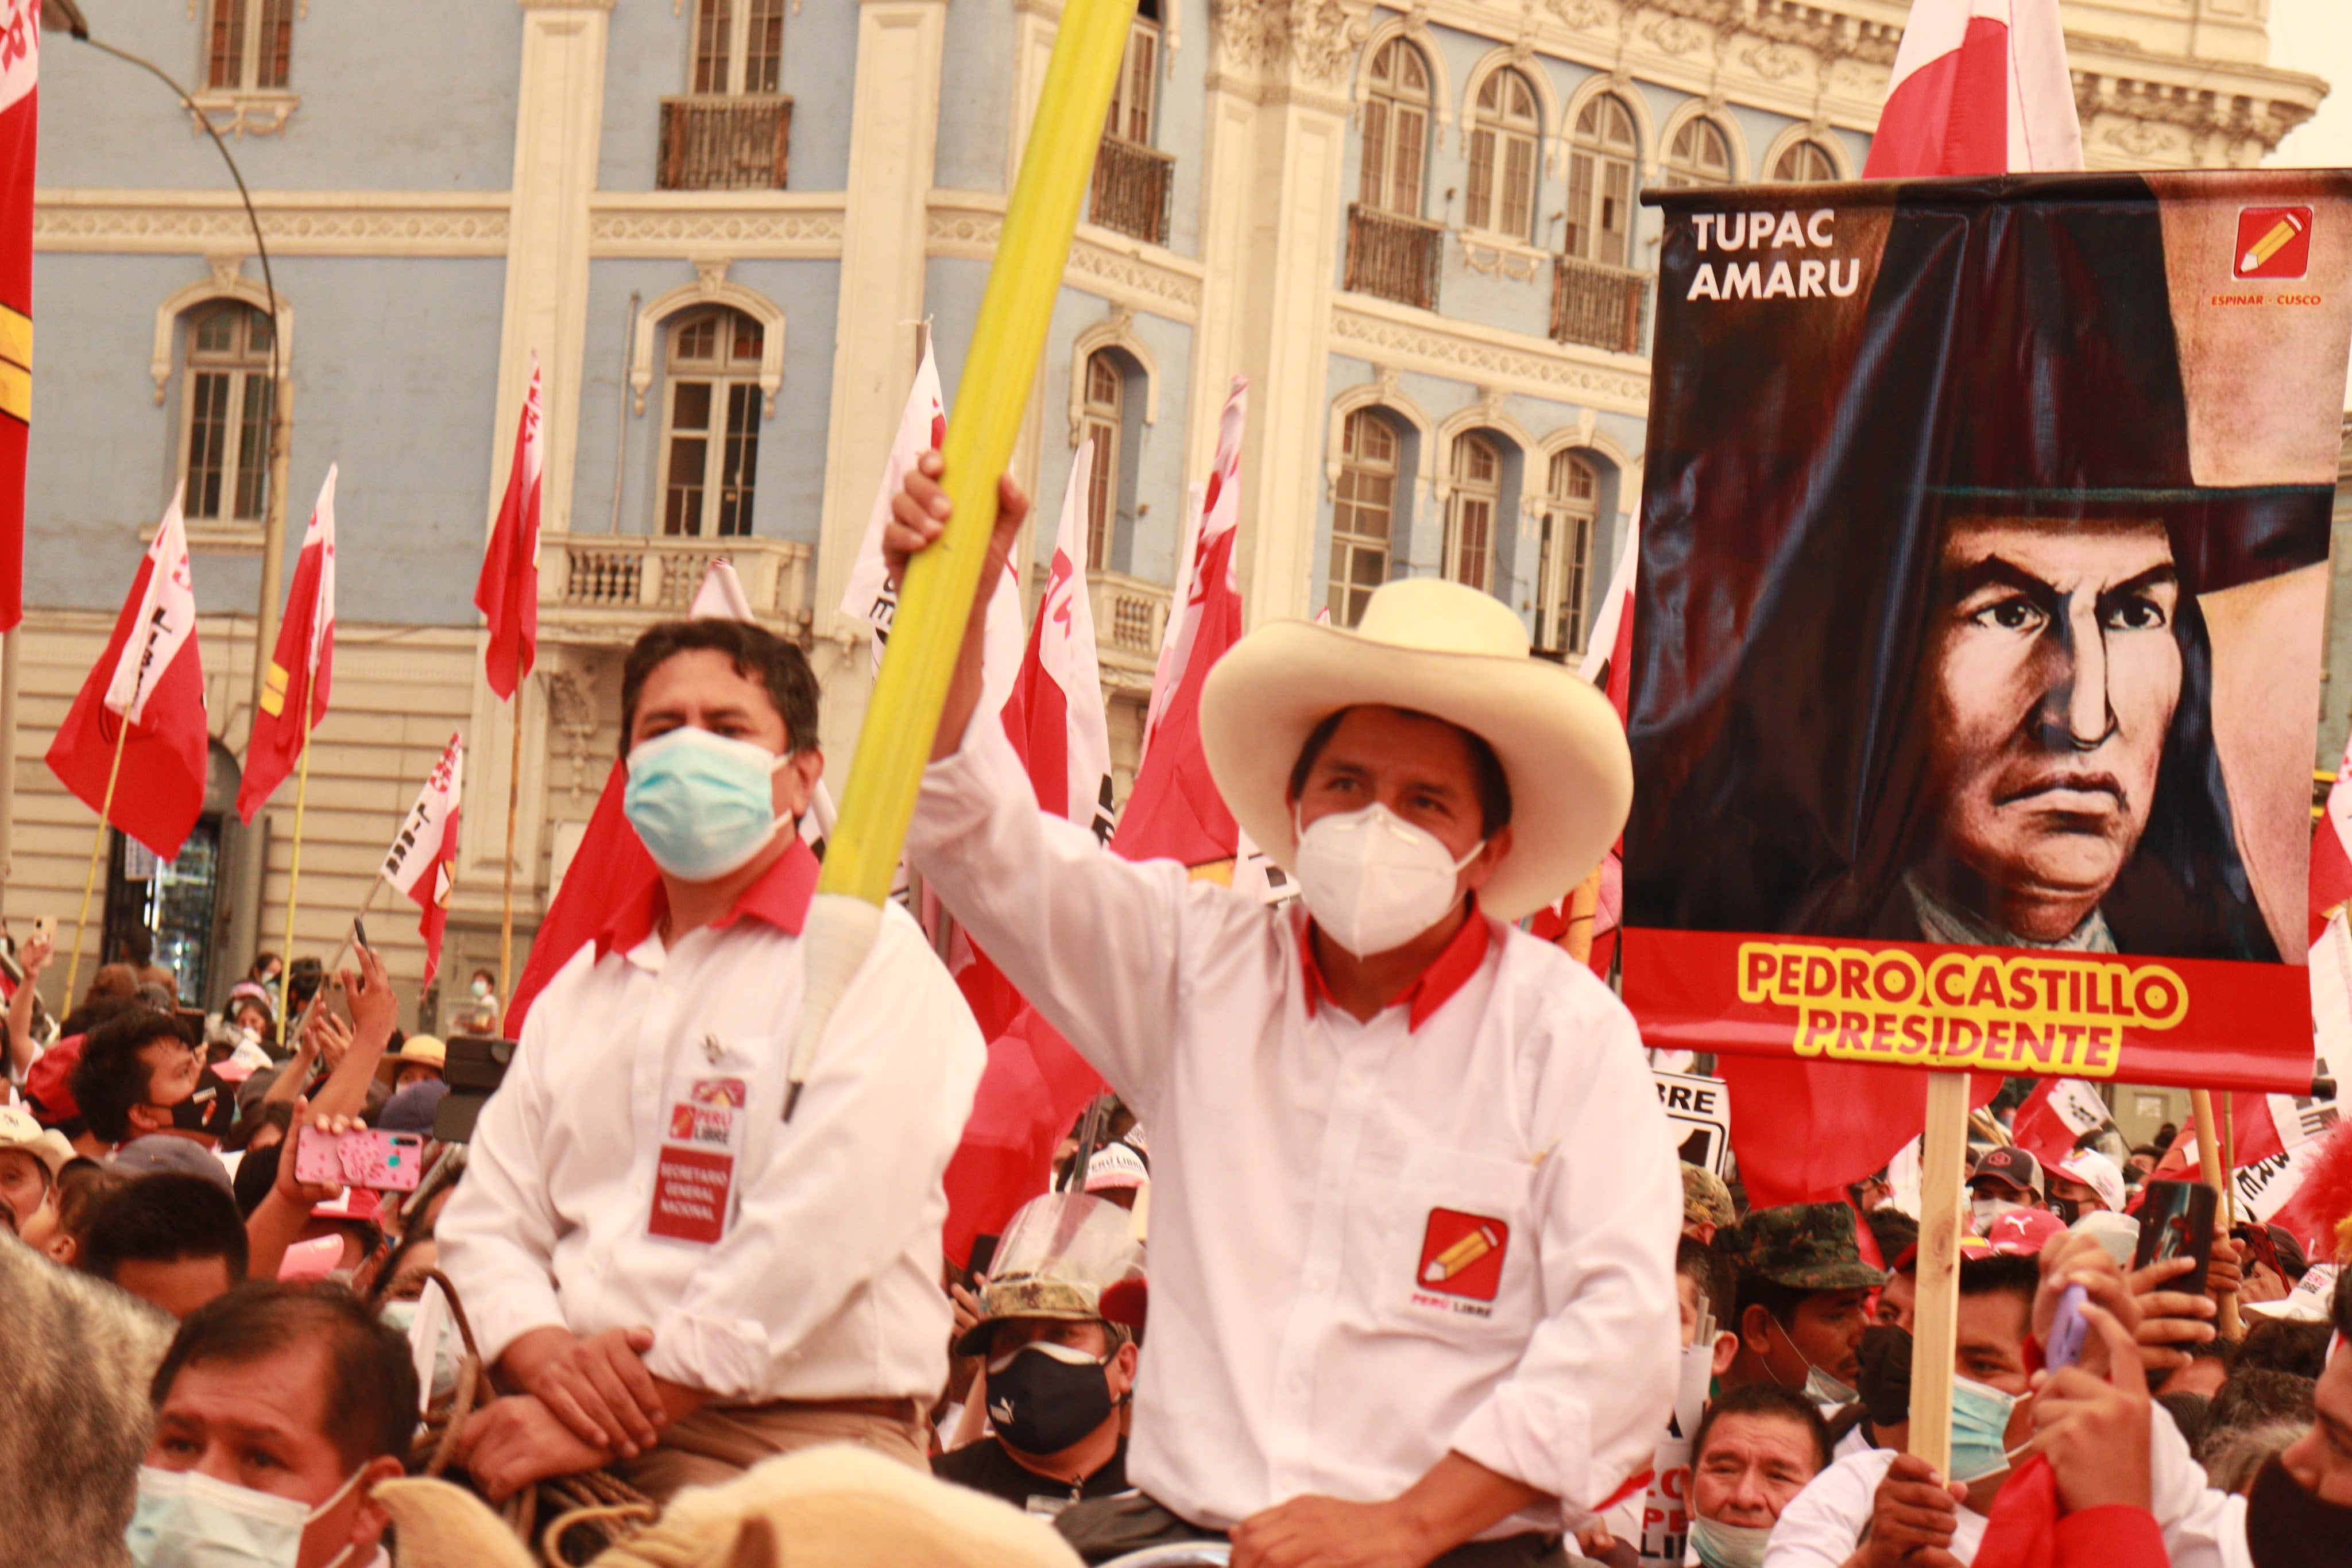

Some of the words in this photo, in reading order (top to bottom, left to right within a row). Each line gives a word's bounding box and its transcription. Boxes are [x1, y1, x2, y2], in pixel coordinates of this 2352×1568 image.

[1692, 208, 1835, 251] TUPAC
[1686, 258, 1860, 301] AMARU
[2211, 295, 2264, 306] ESPINAR
[2276, 295, 2322, 306] CUSCO
[1746, 951, 1918, 1003] PEDRO
[1933, 962, 2180, 1020] CASTILLO
[1802, 1007, 2114, 1067] PRESIDENTE
[1453, 1301, 1492, 1318] LIBRE
